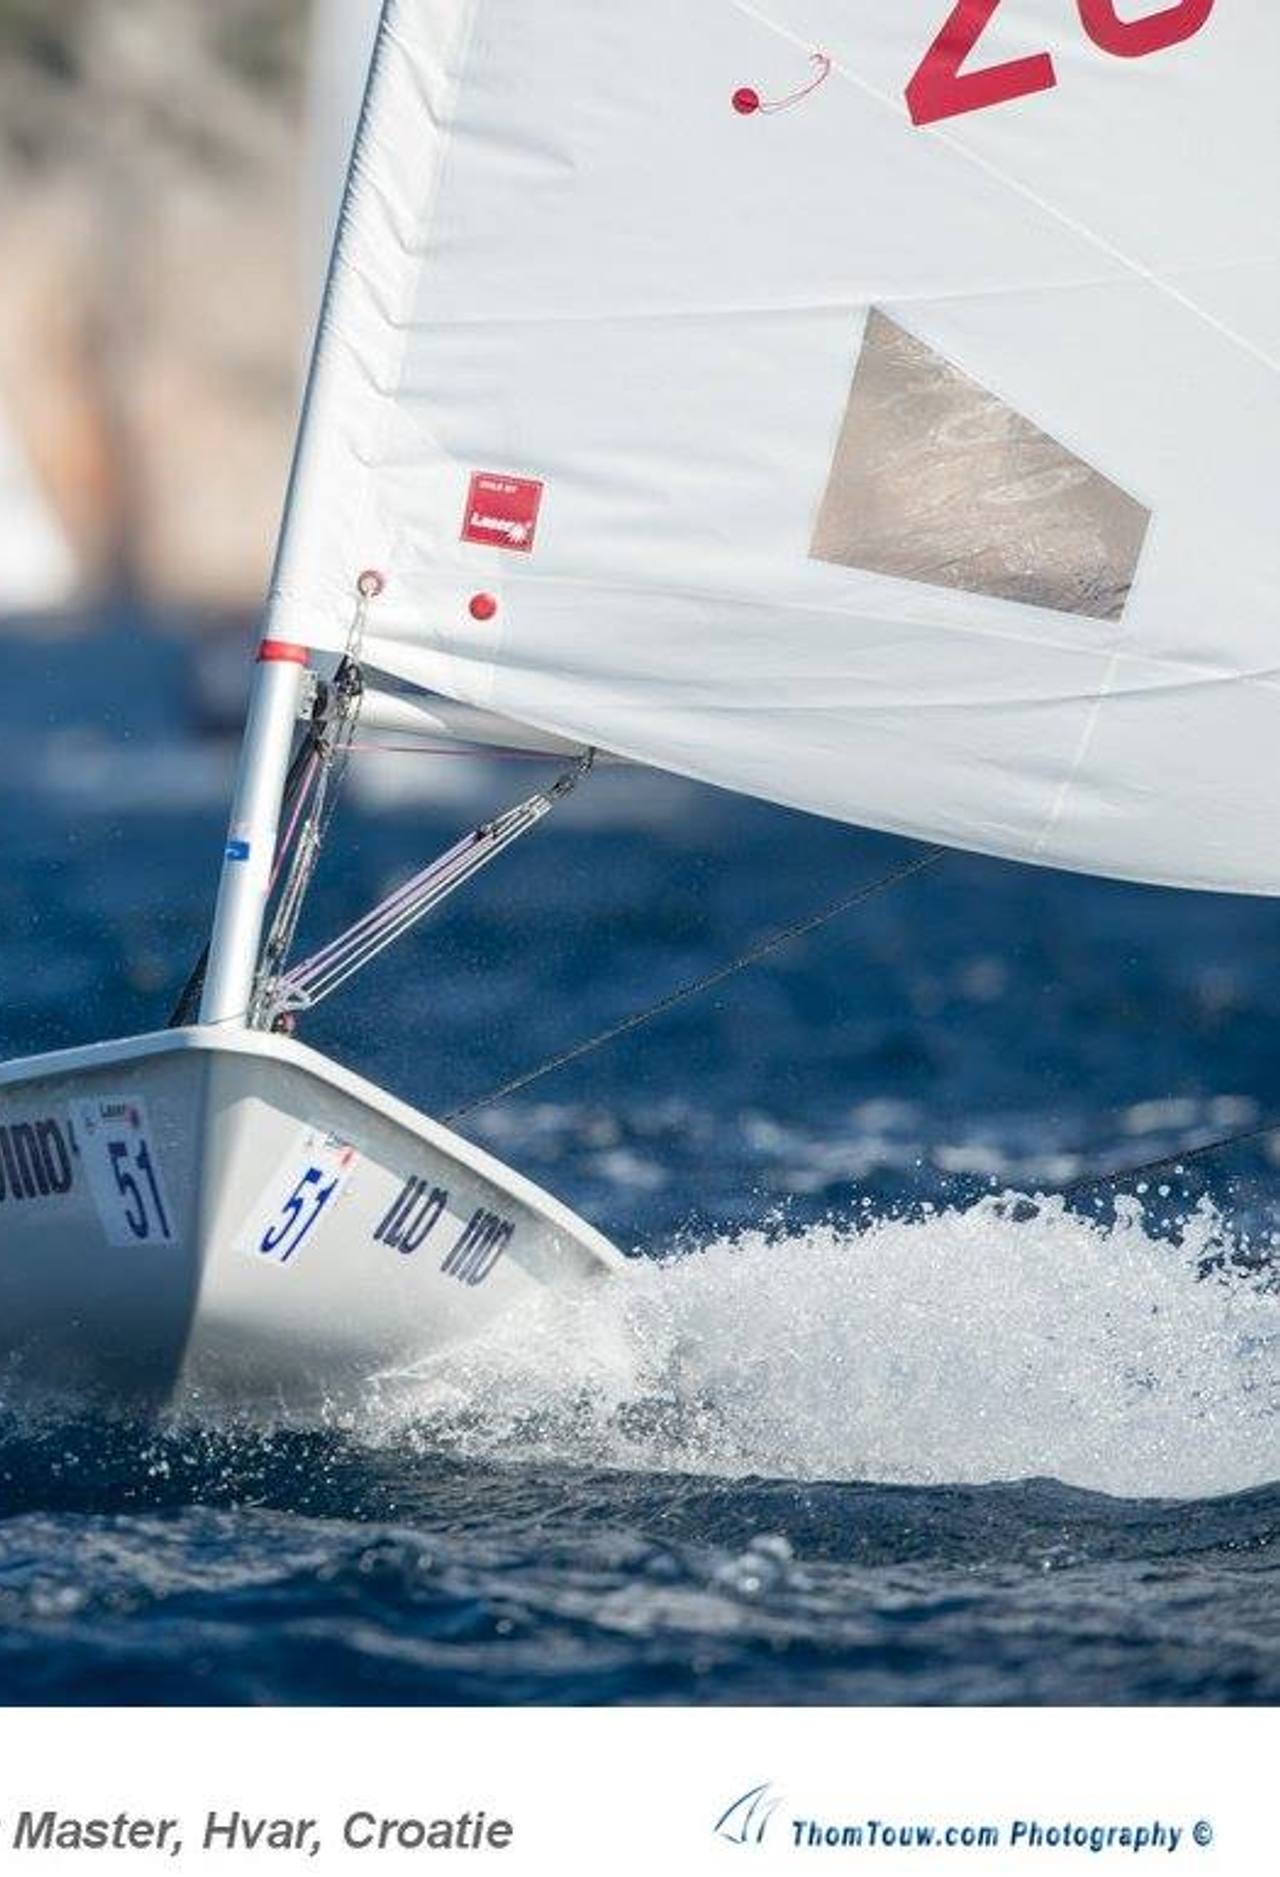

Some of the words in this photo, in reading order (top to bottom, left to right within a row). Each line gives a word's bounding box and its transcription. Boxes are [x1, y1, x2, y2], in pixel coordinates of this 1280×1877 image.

[904, 0, 1214, 126] 2
[107, 1139, 171, 1239] 51
[260, 1167, 339, 1263] 51
